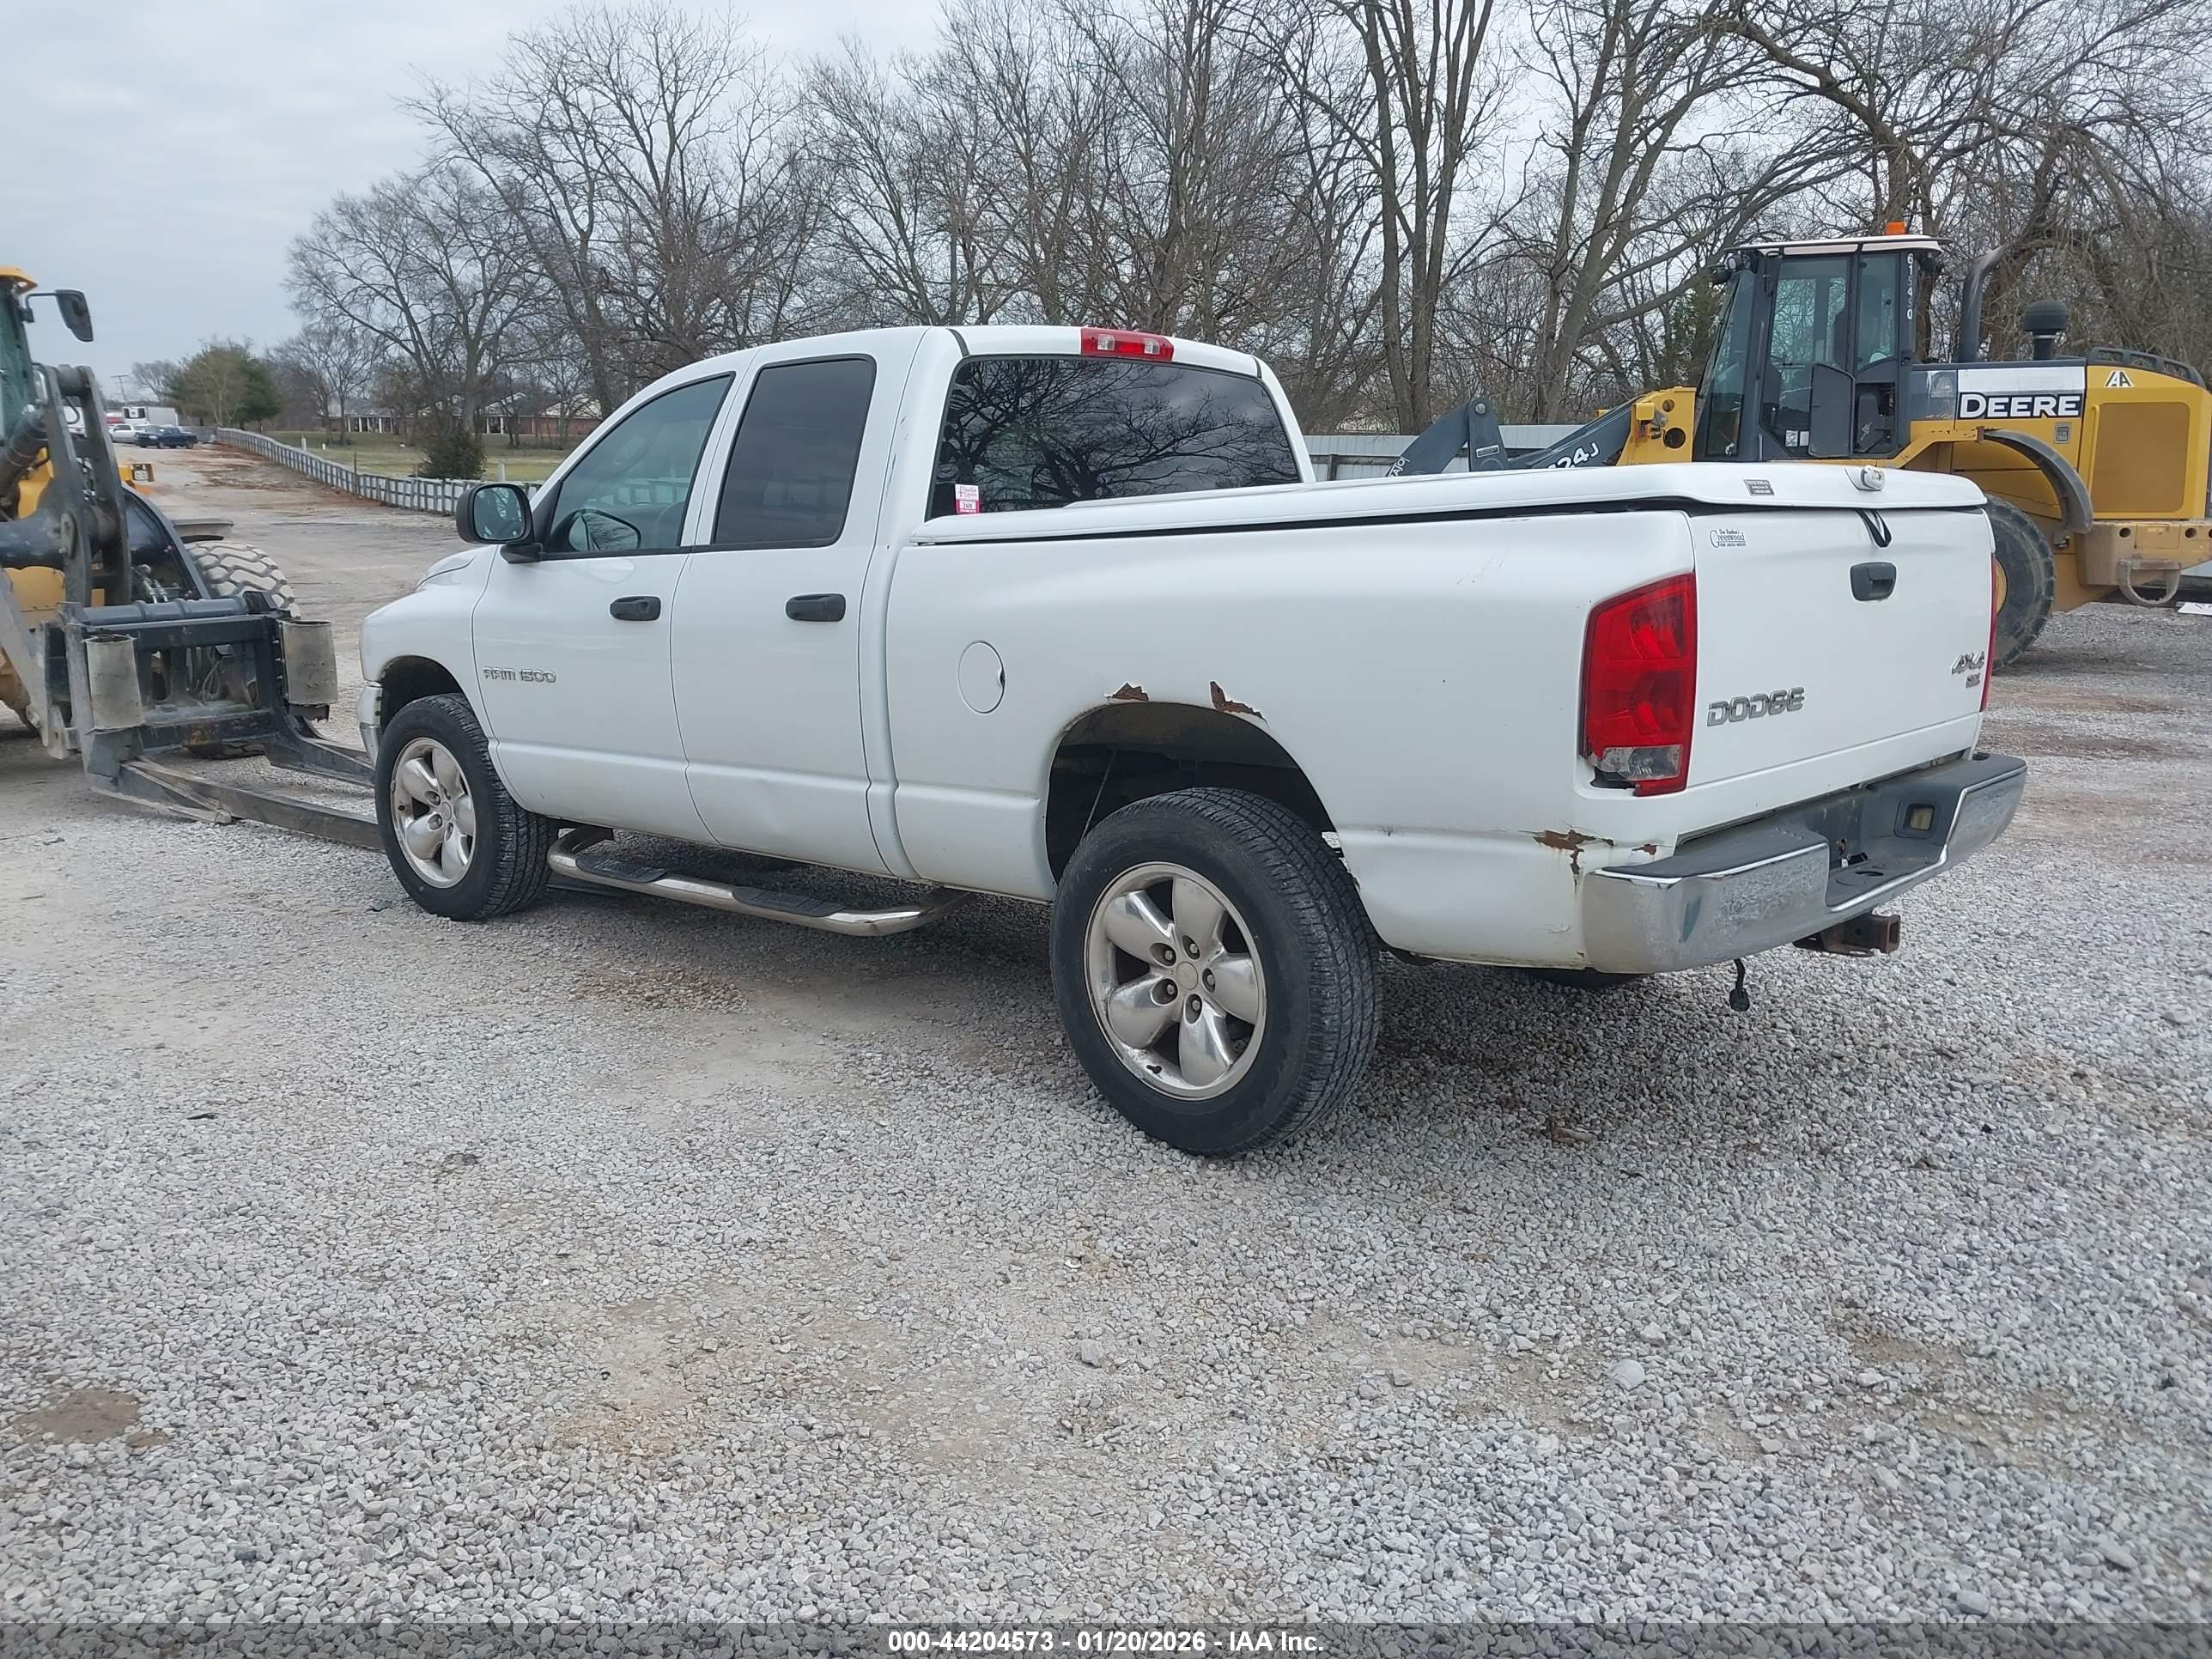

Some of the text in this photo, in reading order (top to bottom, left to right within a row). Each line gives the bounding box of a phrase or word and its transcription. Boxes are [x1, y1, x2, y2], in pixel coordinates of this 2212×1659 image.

[1960, 393, 2081, 418] DEERE
[1547, 441, 1600, 469] 24J
[483, 666, 557, 684] RAM 1500
[1706, 687, 1805, 727] DODGE
